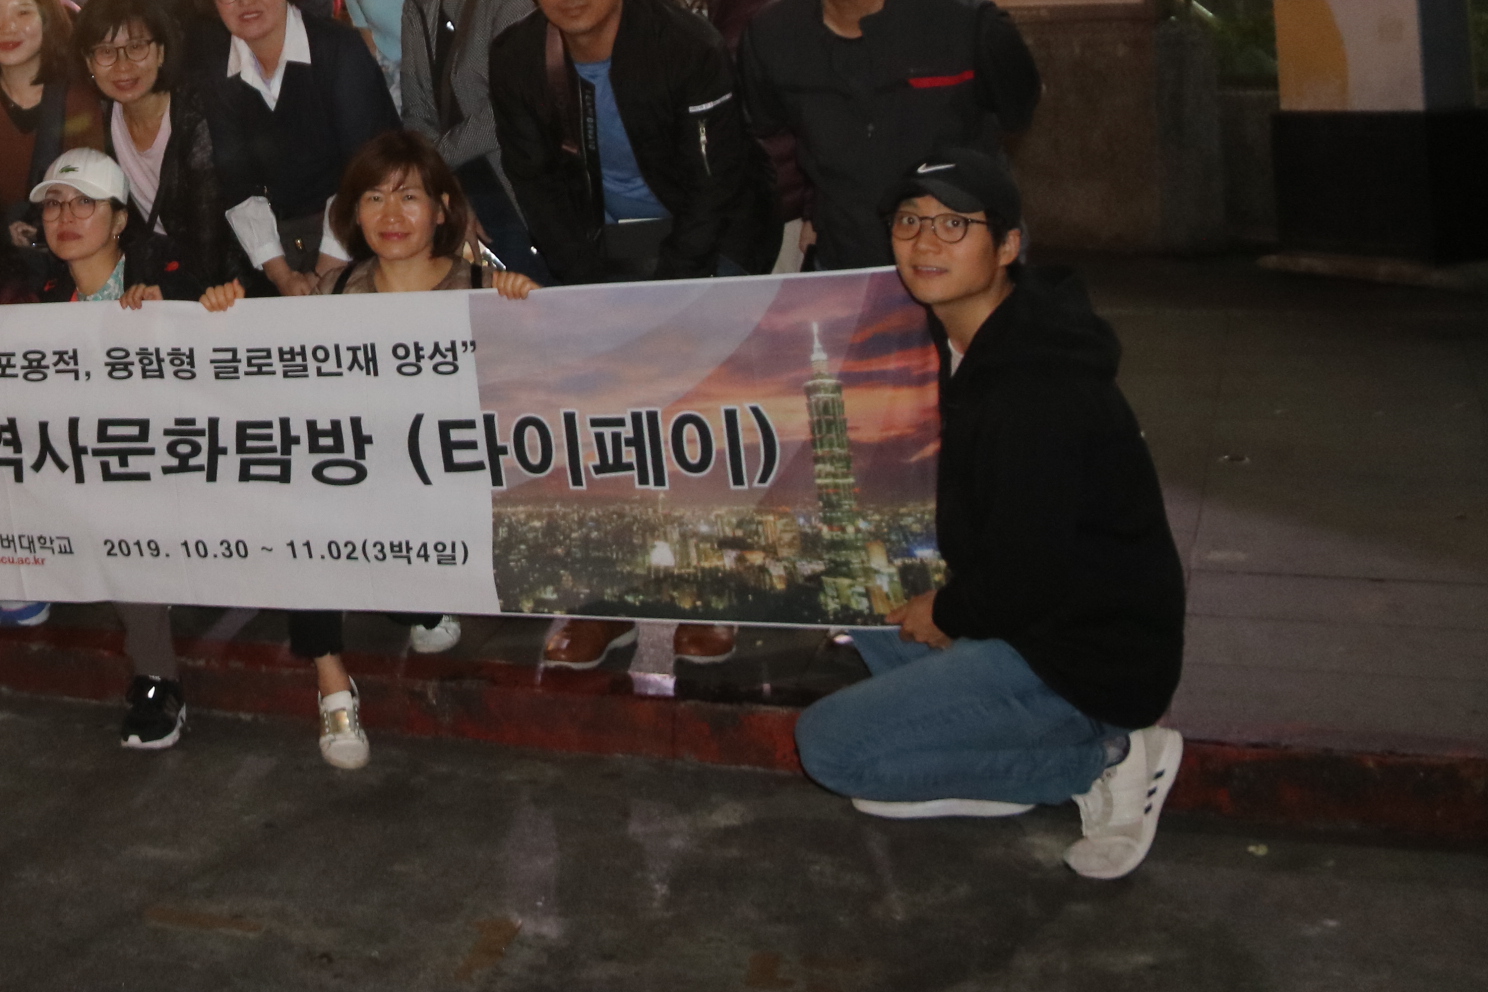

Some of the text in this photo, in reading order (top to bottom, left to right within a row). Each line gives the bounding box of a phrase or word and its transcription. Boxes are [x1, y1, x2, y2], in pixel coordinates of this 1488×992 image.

[102, 345, 197, 381] 융합형
[208, 342, 379, 380] 글로벌인재
[391, 339, 478, 377] 양성”
[407, 404, 780, 490] (타이페이)
[102, 537, 172, 558] 2019.
[180, 537, 250, 559] 10.30
[286, 538, 470, 568] 11.02(3박4일)
